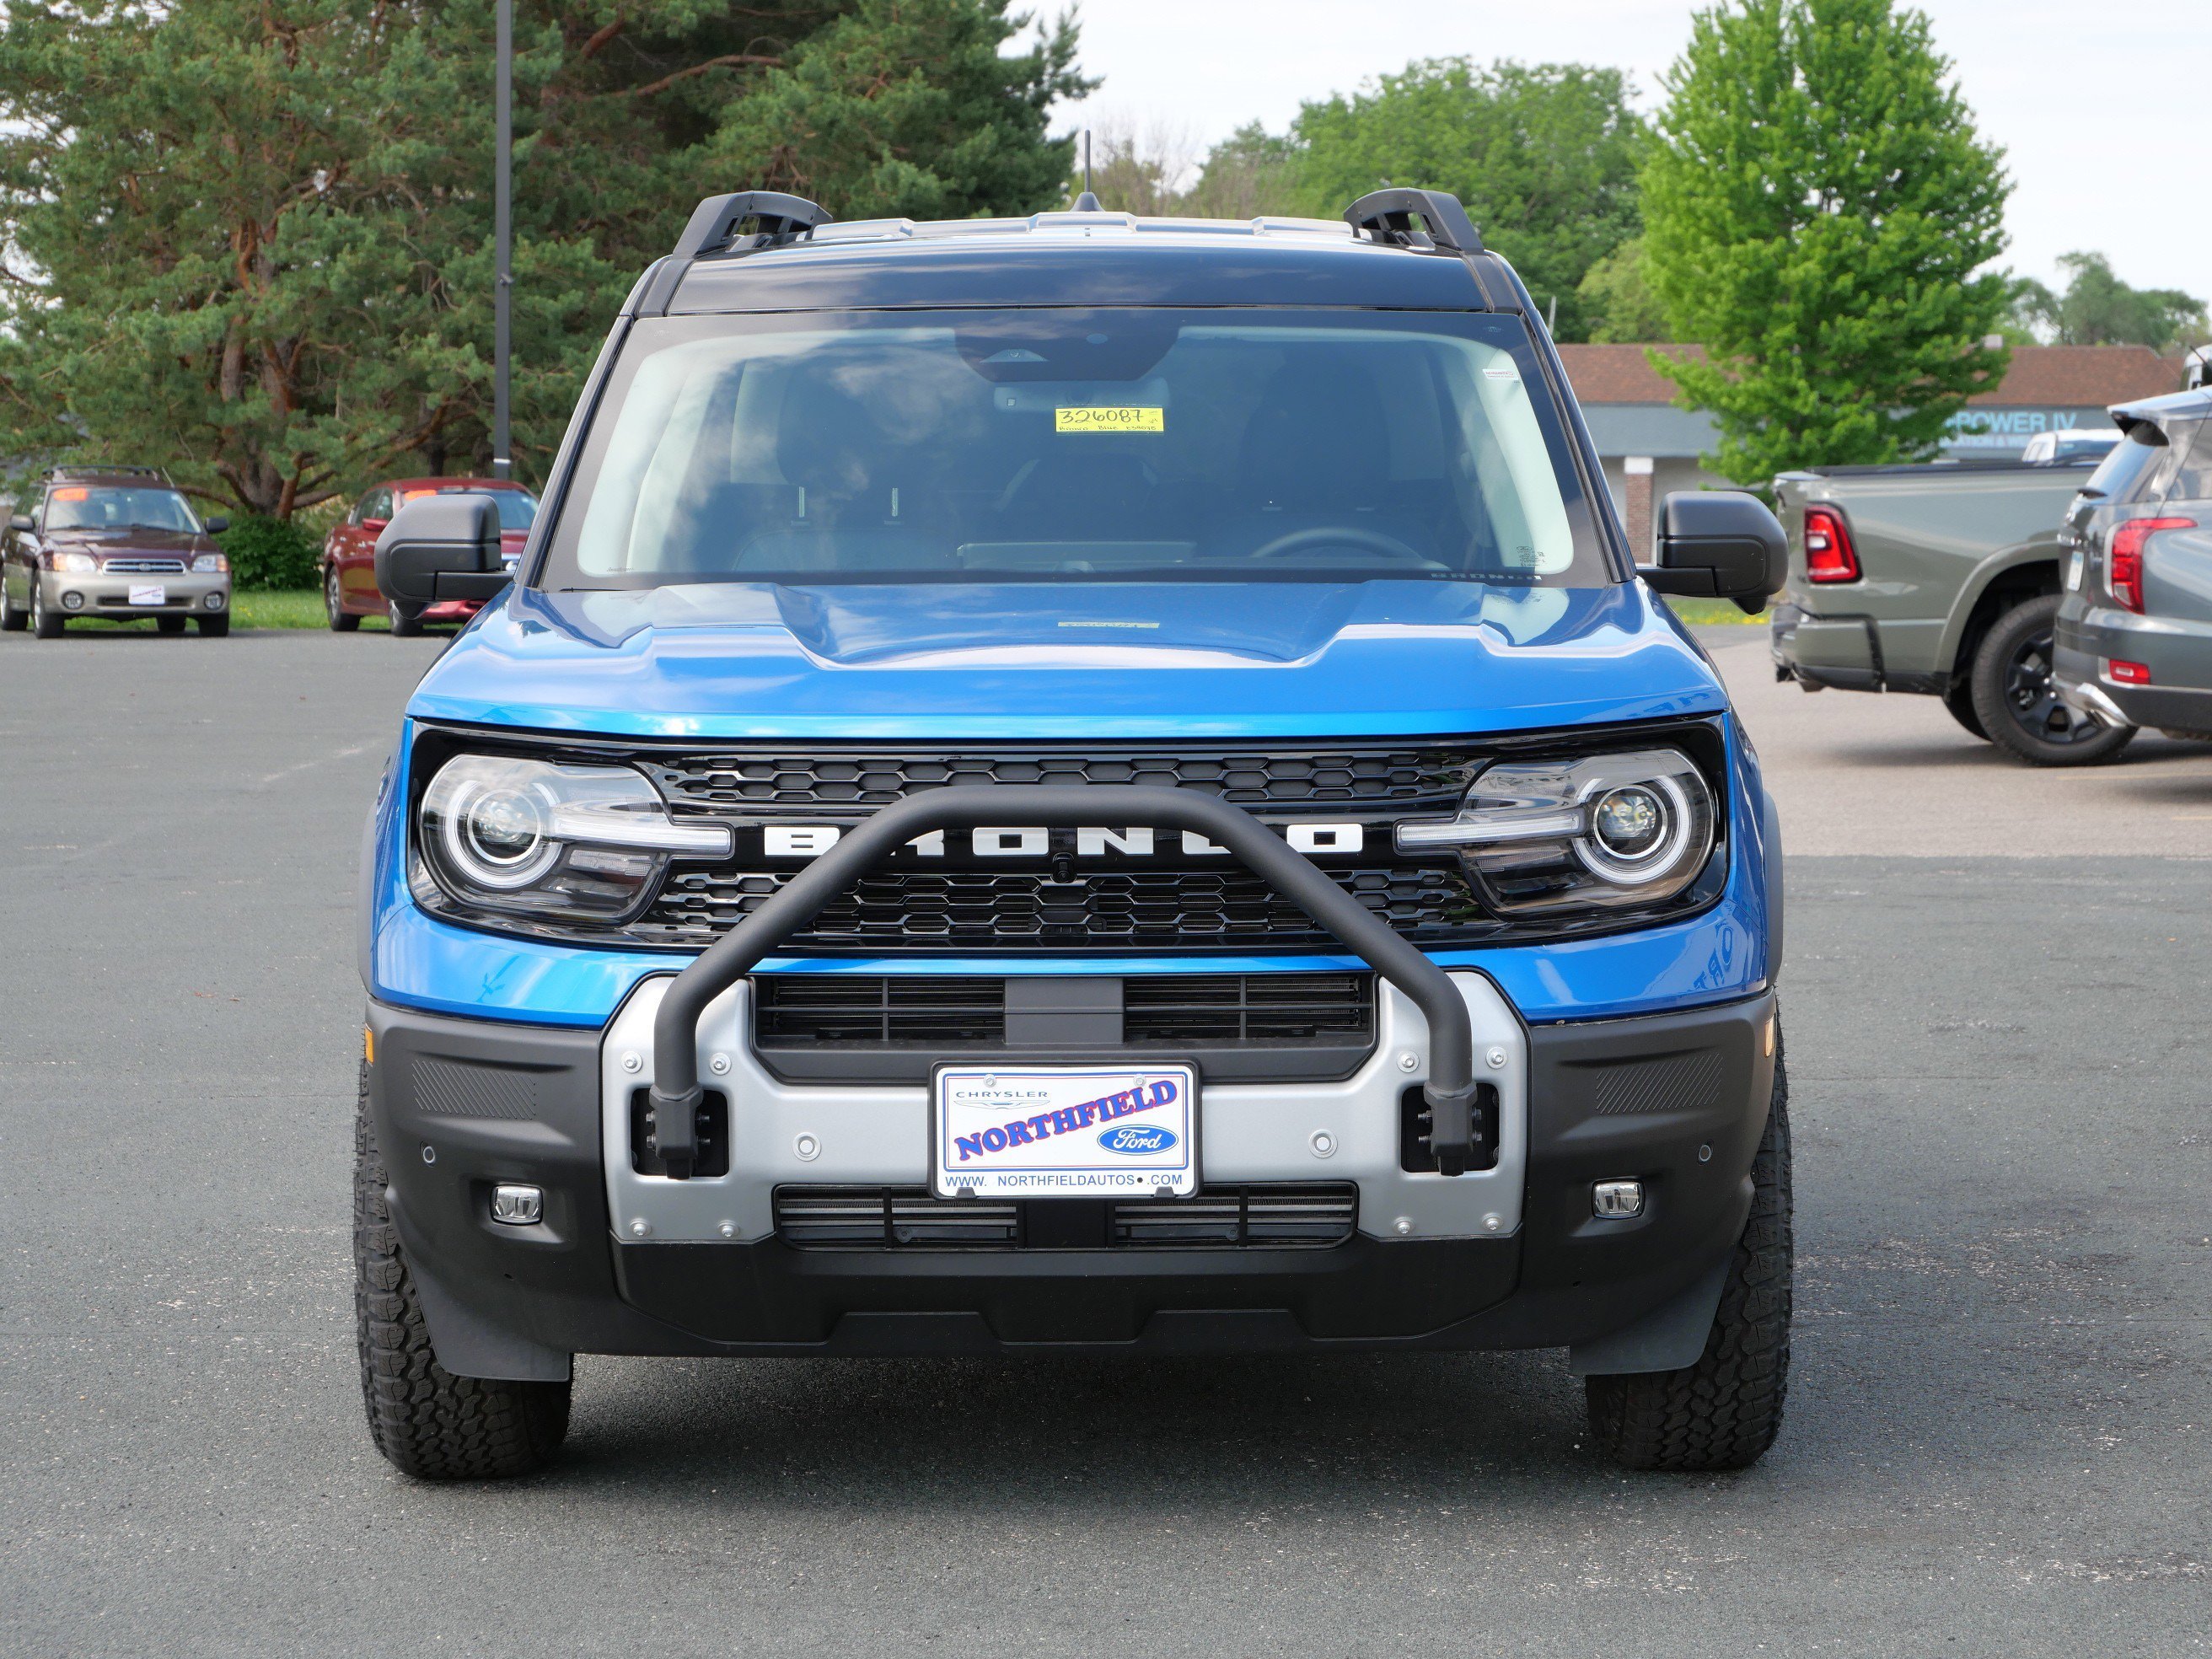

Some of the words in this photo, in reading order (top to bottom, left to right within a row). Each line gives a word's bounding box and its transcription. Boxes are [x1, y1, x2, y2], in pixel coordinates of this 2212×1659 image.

[1058, 409, 1144, 424] 326087
[1944, 411, 2047, 432] POWER
[953, 1079, 1178, 1162] NORTHFIELD
[1113, 1128, 1162, 1150] Ford
